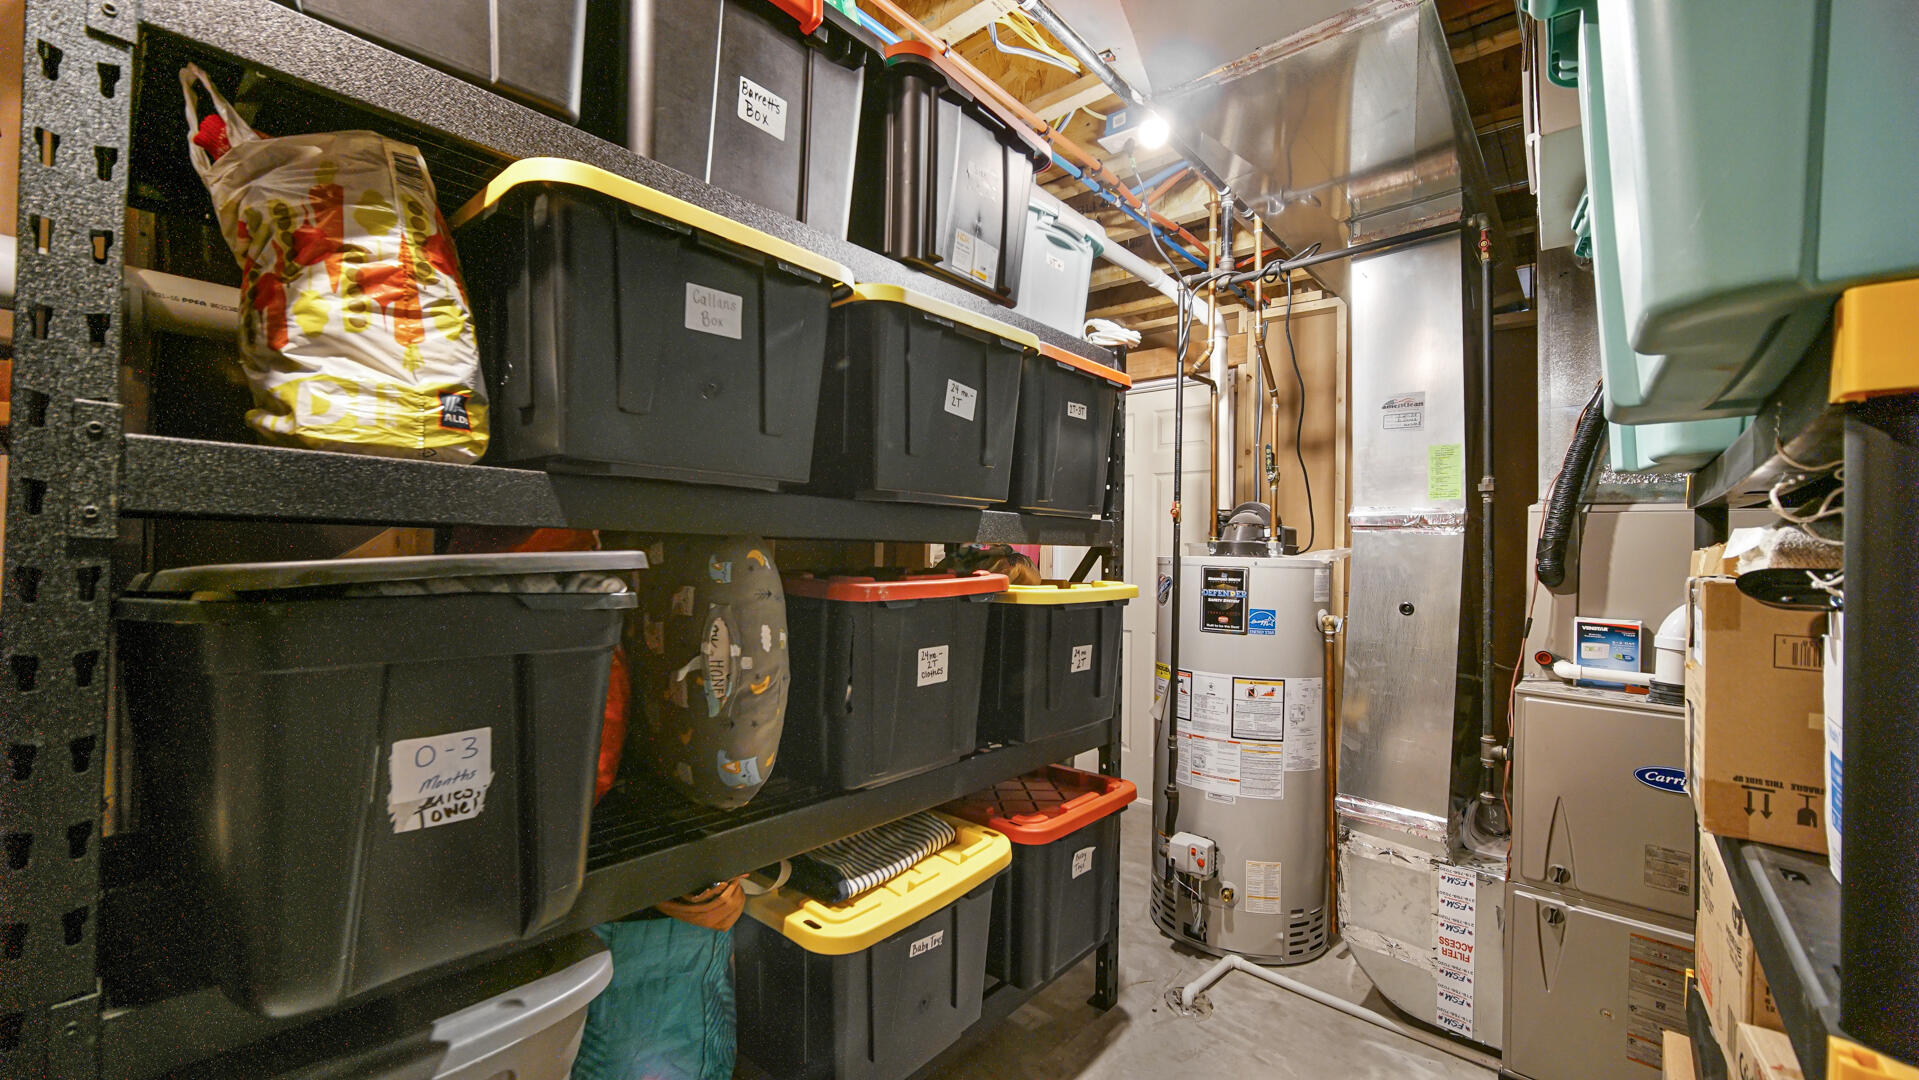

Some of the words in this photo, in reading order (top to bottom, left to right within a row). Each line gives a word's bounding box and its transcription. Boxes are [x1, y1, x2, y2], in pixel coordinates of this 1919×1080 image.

[952, 396, 962, 408] 2T
[1202, 588, 1248, 599] DEFENDER
[419, 769, 477, 793] Months
[1733, 775, 1744, 783] UP
[1745, 776, 1763, 786] SIDE
[1765, 780, 1784, 790] THIS
[1447, 876, 1467, 887] FSM
[1446, 899, 1467, 911] FSM
[1445, 923, 1466, 935] FSM
[1438, 936, 1473, 953] ACCESS
[1442, 946, 1471, 963] FILTER
[1445, 969, 1466, 982] FSM
[1444, 993, 1465, 1006] FSM
[1443, 1017, 1465, 1030] FSM
